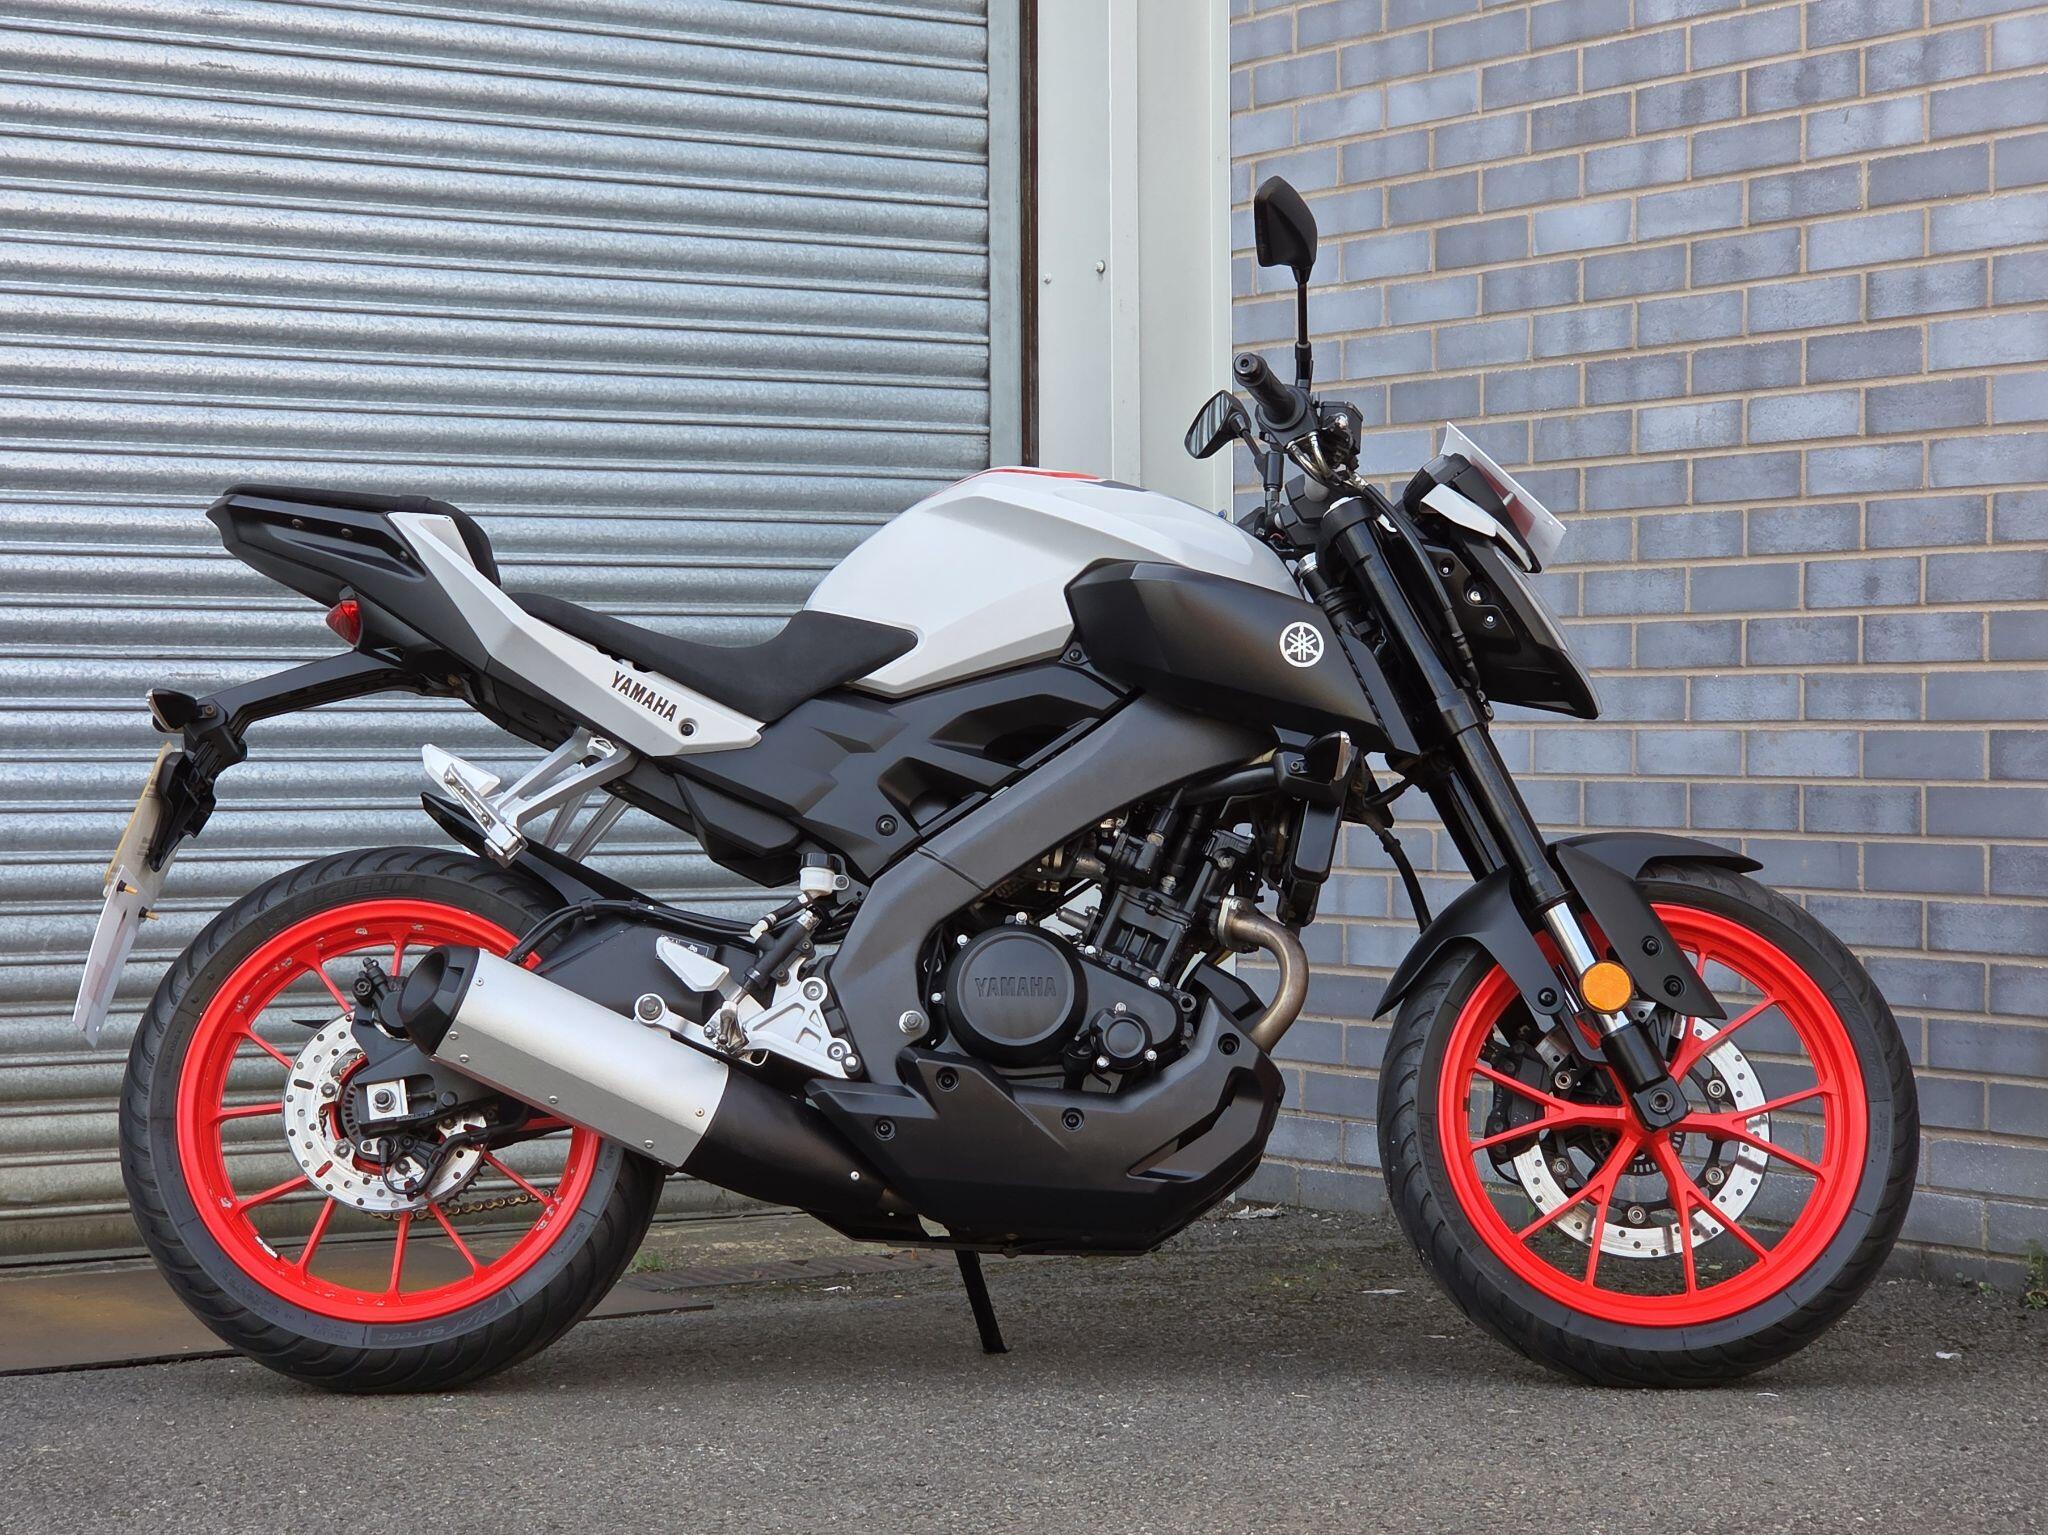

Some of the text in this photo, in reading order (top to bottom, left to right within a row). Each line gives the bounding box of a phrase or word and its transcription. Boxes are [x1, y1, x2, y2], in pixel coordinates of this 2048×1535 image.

[611, 670, 677, 722] YAMAHA
[974, 976, 1057, 998] YAMAHA
[378, 1325, 446, 1342] Street
